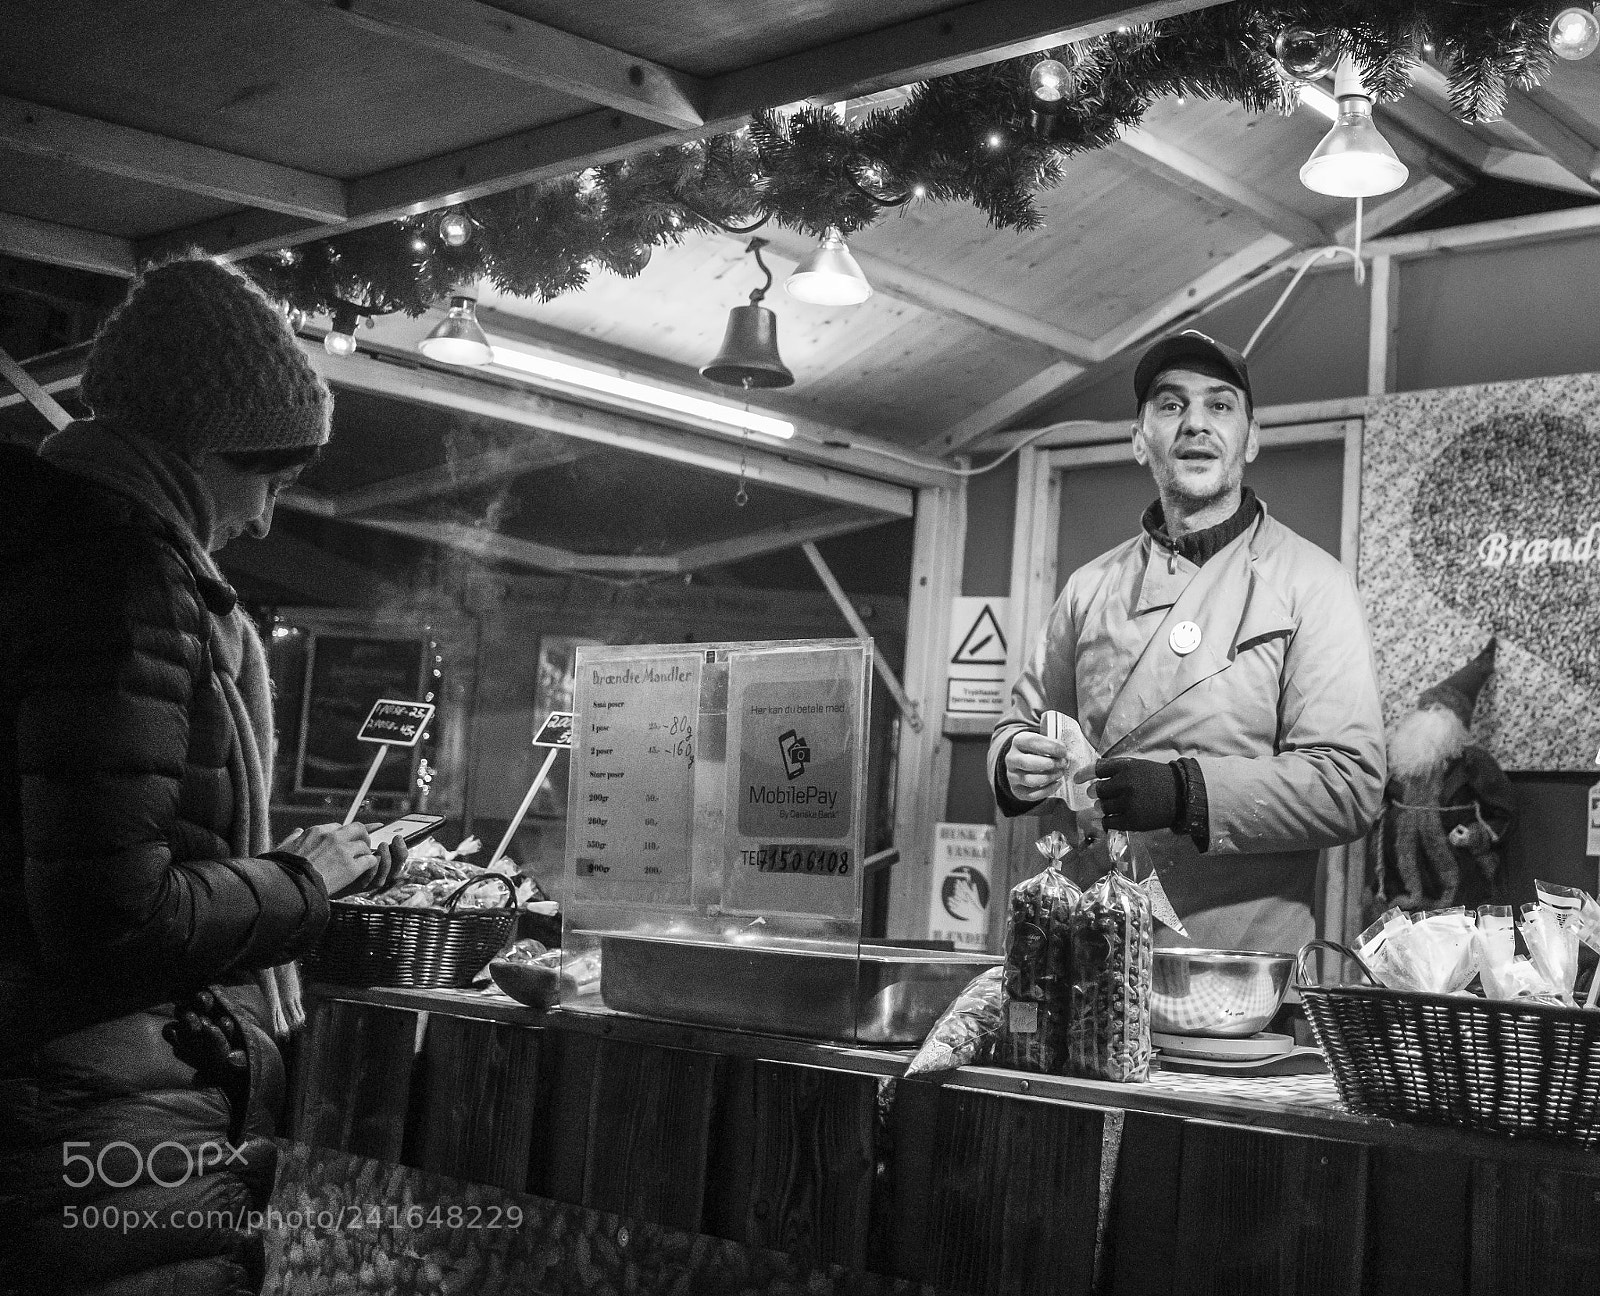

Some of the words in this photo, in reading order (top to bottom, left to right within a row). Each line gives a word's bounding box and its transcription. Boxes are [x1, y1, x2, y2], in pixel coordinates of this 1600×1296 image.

[1479, 521, 1600, 567] Brænd
[643, 666, 693, 683] Mandler
[751, 705, 767, 715] Her
[768, 705, 784, 715] kan
[784, 703, 796, 714] du
[796, 703, 825, 714] betale
[825, 703, 846, 713] med
[749, 785, 838, 809] MobilePay
[779, 809, 789, 819] By
